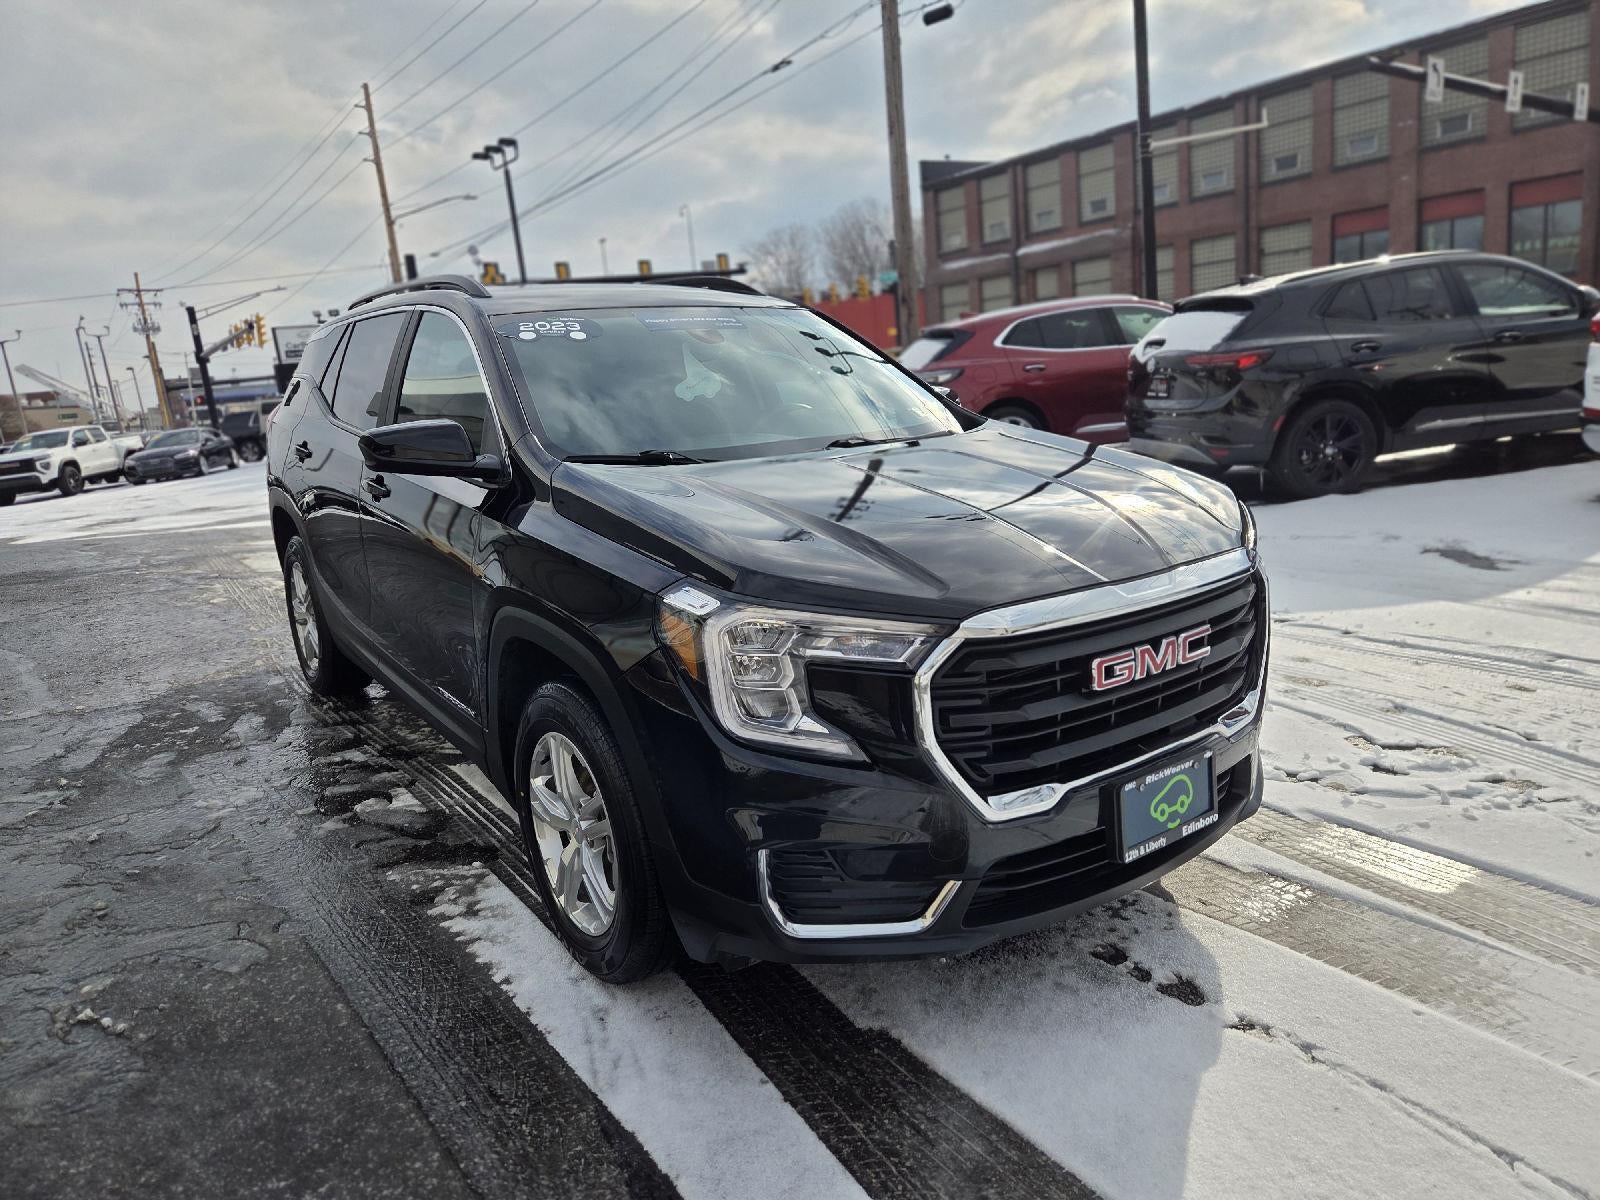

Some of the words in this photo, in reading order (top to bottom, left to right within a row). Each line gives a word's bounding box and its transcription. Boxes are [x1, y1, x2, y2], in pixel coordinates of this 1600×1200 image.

[518, 321, 581, 331] 2023
[1091, 624, 1212, 691] GMC
[1182, 813, 1219, 837] Edinboro
[1125, 847, 1139, 863] 12th
[1139, 845, 1146, 855] &
[1146, 837, 1167, 852] Liberty
